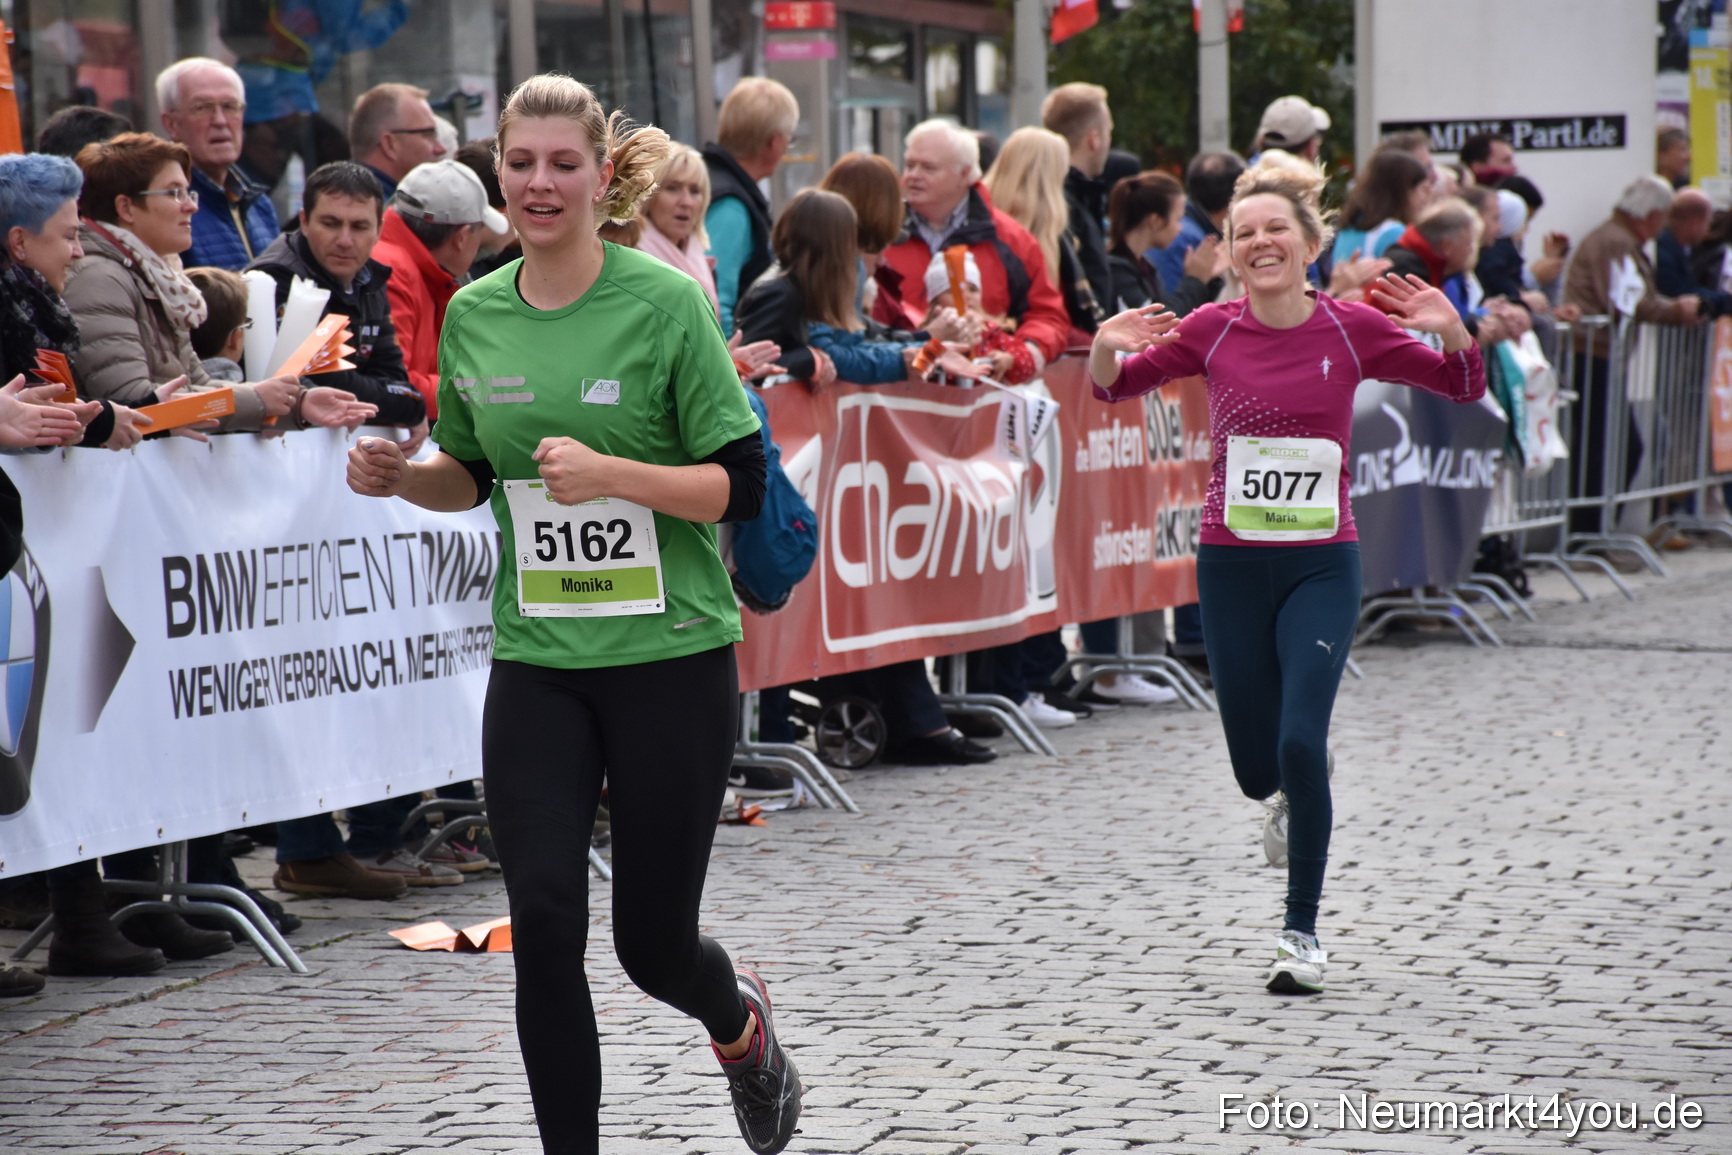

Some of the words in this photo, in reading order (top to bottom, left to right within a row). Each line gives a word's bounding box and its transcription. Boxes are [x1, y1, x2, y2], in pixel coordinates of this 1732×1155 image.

[594, 381, 618, 393] AOK
[1270, 448, 1308, 457] BOCK
[1242, 469, 1322, 501] 5077
[1265, 511, 1298, 523] Maria
[534, 518, 636, 562] 5162
[523, 556, 529, 564] S
[561, 577, 613, 593] Monika
[162, 549, 257, 639] BMW
[168, 656, 274, 720] WENIGER
[271, 639, 403, 706] VERBRAUCH.
